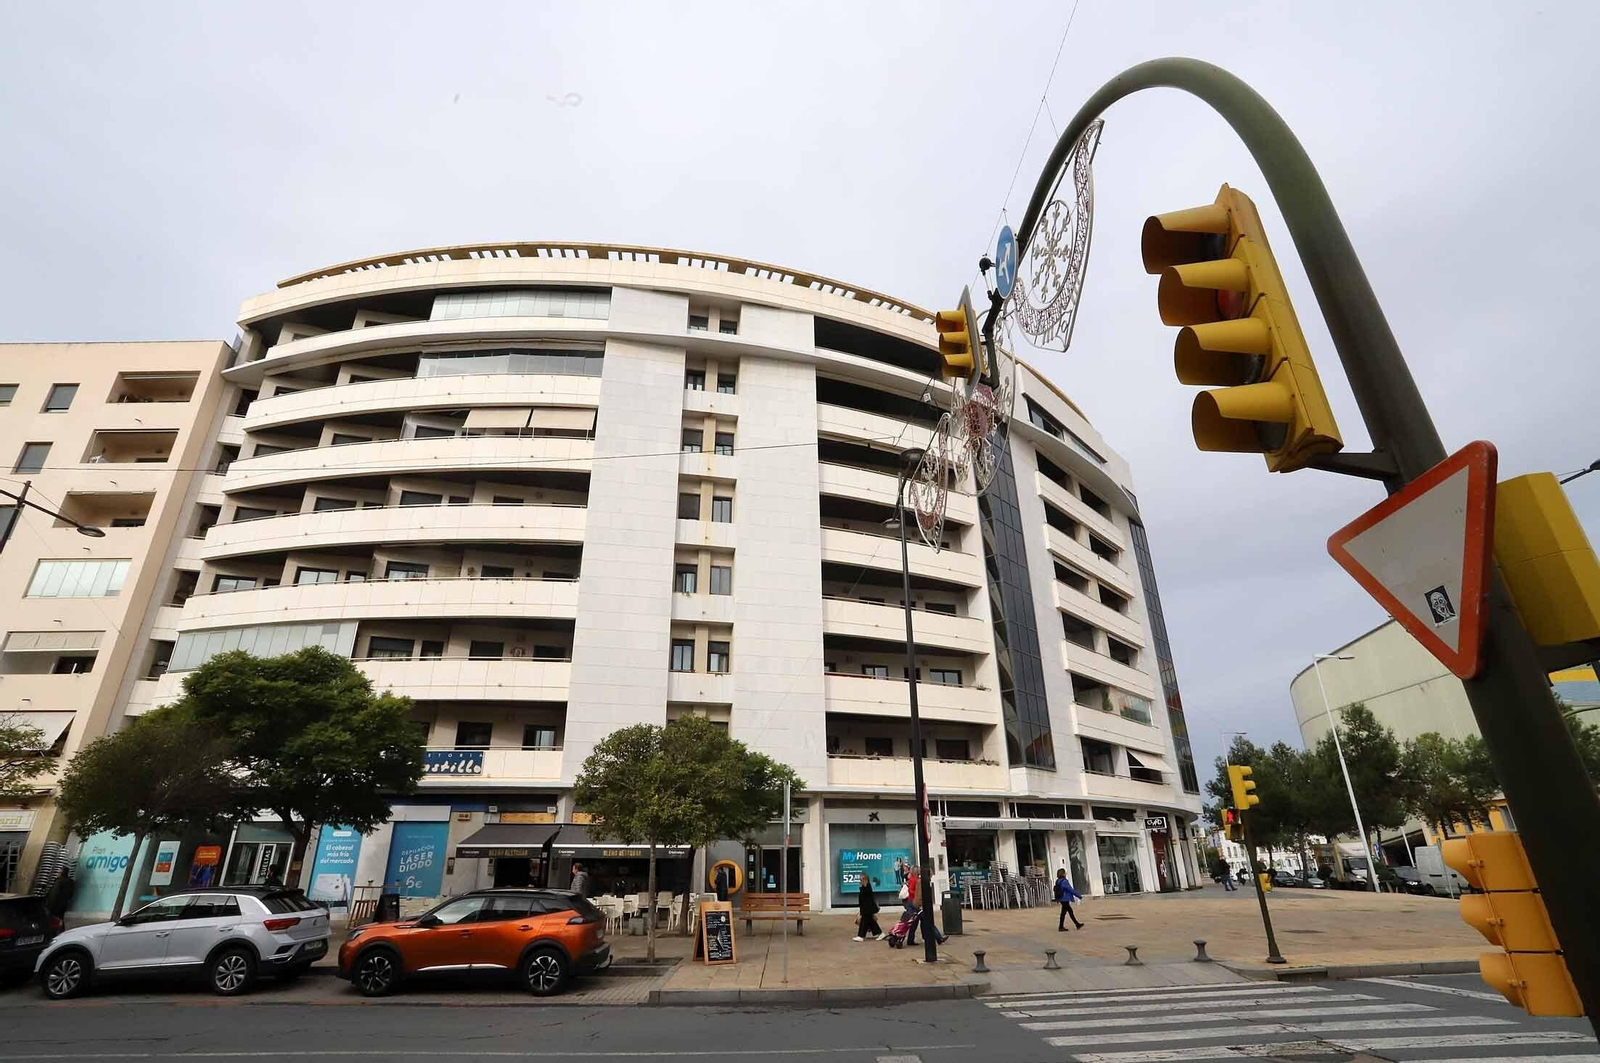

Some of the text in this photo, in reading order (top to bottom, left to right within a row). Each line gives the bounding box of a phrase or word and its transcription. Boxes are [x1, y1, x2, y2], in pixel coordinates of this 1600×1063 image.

[86, 852, 129, 873] amigo
[400, 851, 433, 865] LÁSER
[399, 859, 432, 873] DIODO
